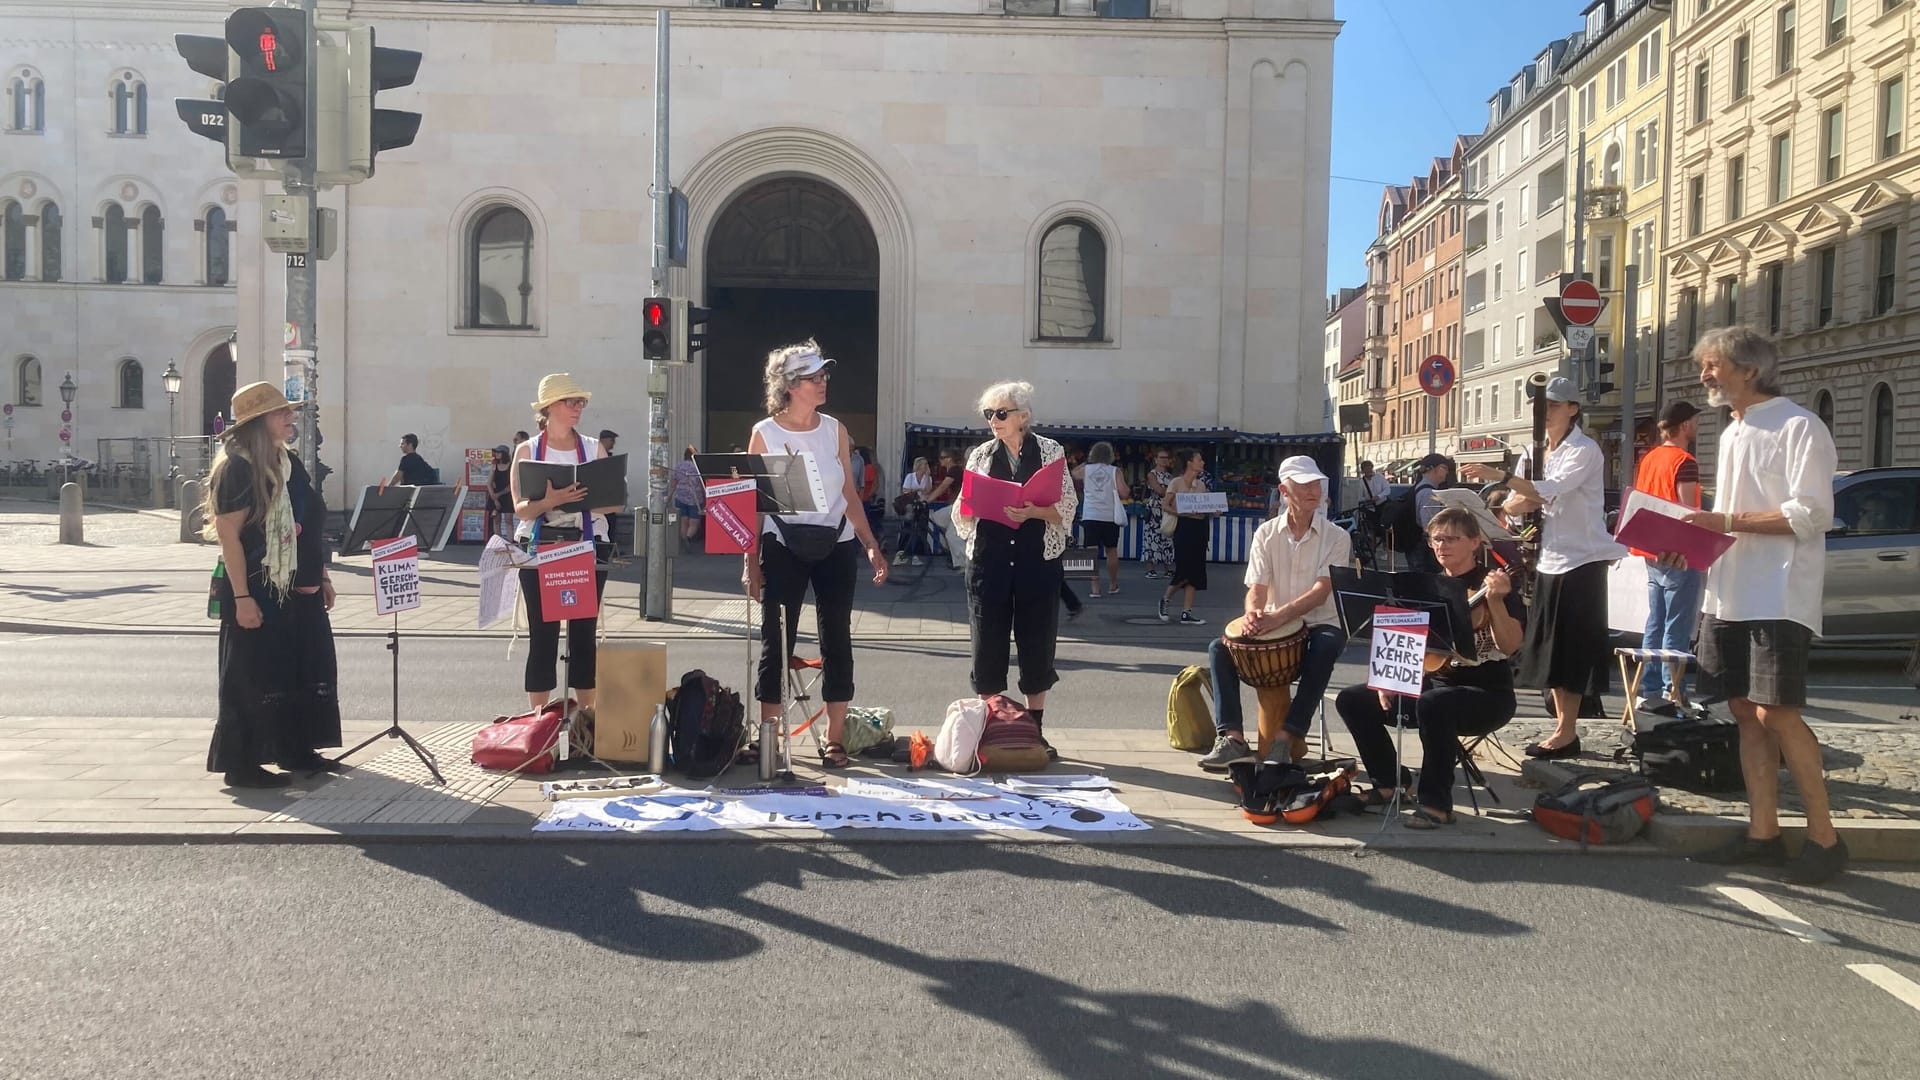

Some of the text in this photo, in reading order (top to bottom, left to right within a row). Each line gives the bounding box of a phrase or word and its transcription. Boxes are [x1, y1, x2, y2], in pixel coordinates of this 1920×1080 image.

[202, 114, 224, 126] 022
[678, 205, 686, 250] U
[287, 255, 305, 267] 712
[710, 505, 724, 522] Nein
[378, 562, 416, 575] KLIMA-
[566, 569, 589, 577] NEUEN
[380, 572, 417, 585] GERECH-
[545, 577, 590, 587] AUTOBAHNEN
[380, 581, 419, 595] TIGKEIT
[386, 592, 419, 610] JETZT
[1382, 632, 1423, 650] VER-
[1375, 646, 1423, 666] KEHRS-
[1371, 661, 1421, 686] WENDE
